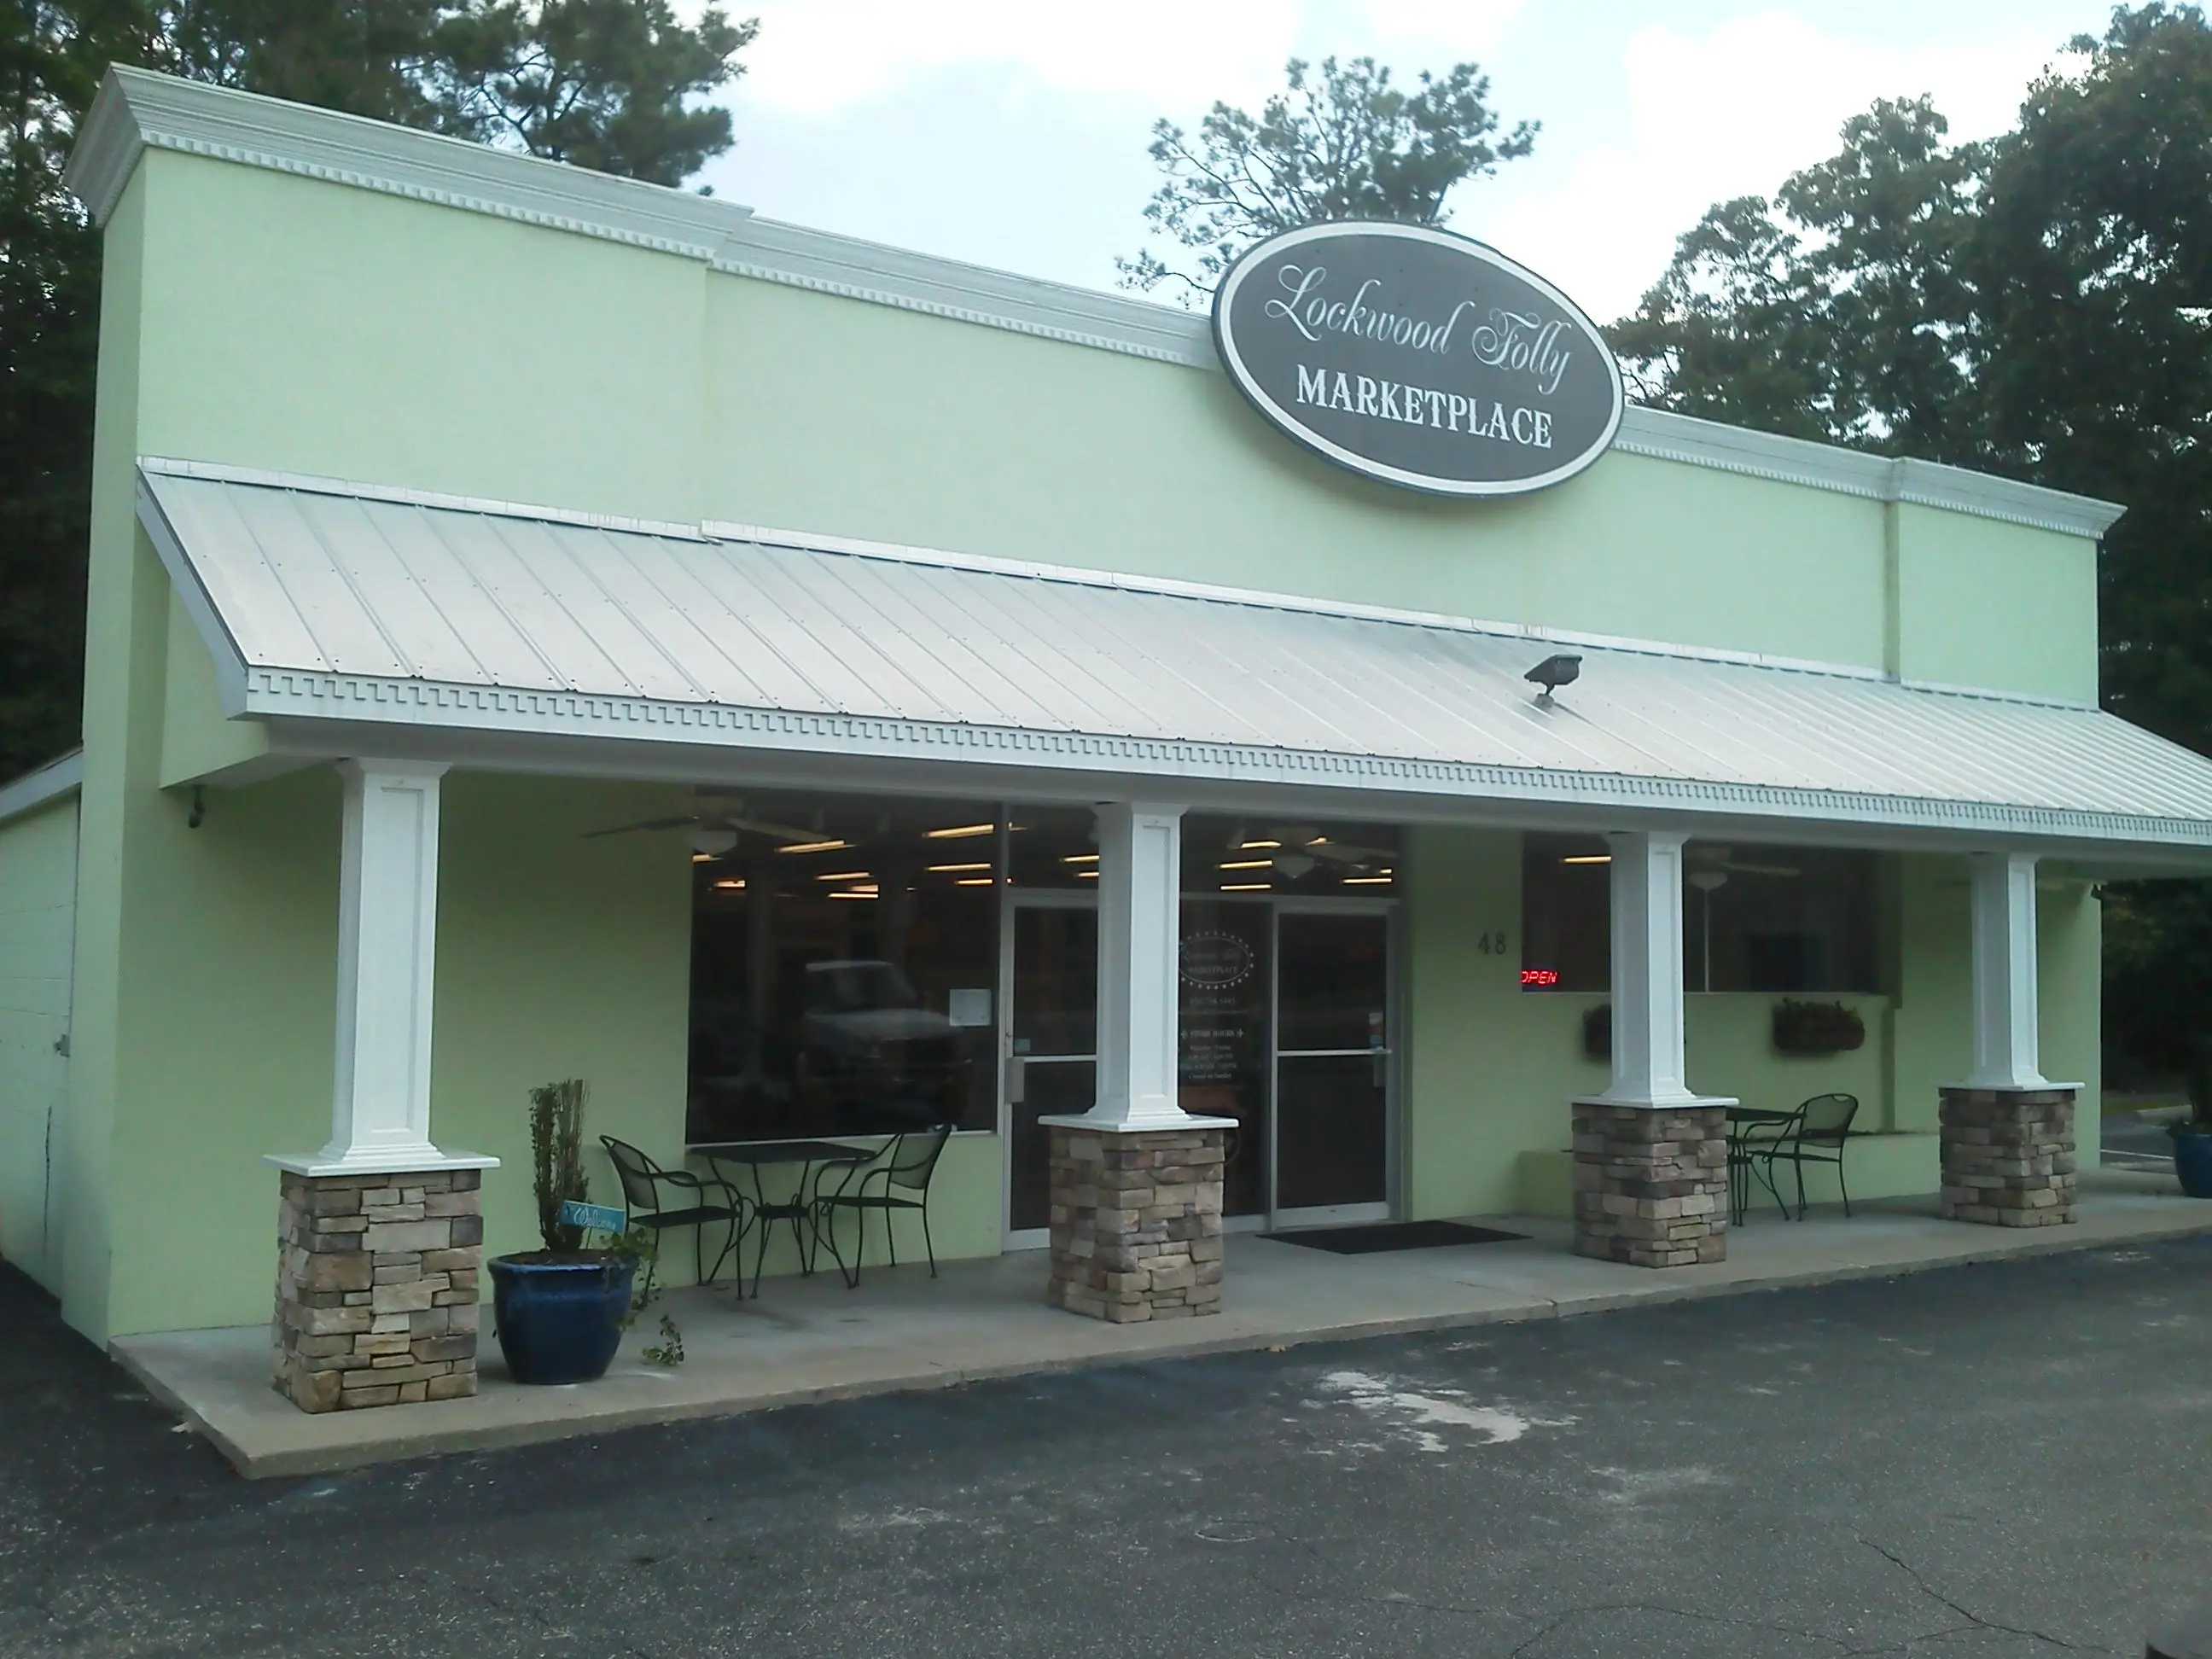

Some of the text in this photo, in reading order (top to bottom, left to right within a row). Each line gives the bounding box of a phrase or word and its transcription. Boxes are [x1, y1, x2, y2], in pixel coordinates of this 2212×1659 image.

[1264, 264, 1573, 396] Lockwood Folly
[1295, 364, 1554, 450] MARKETPLACE
[1477, 931, 1506, 955] 48
[1521, 970, 1558, 985] OPEN
